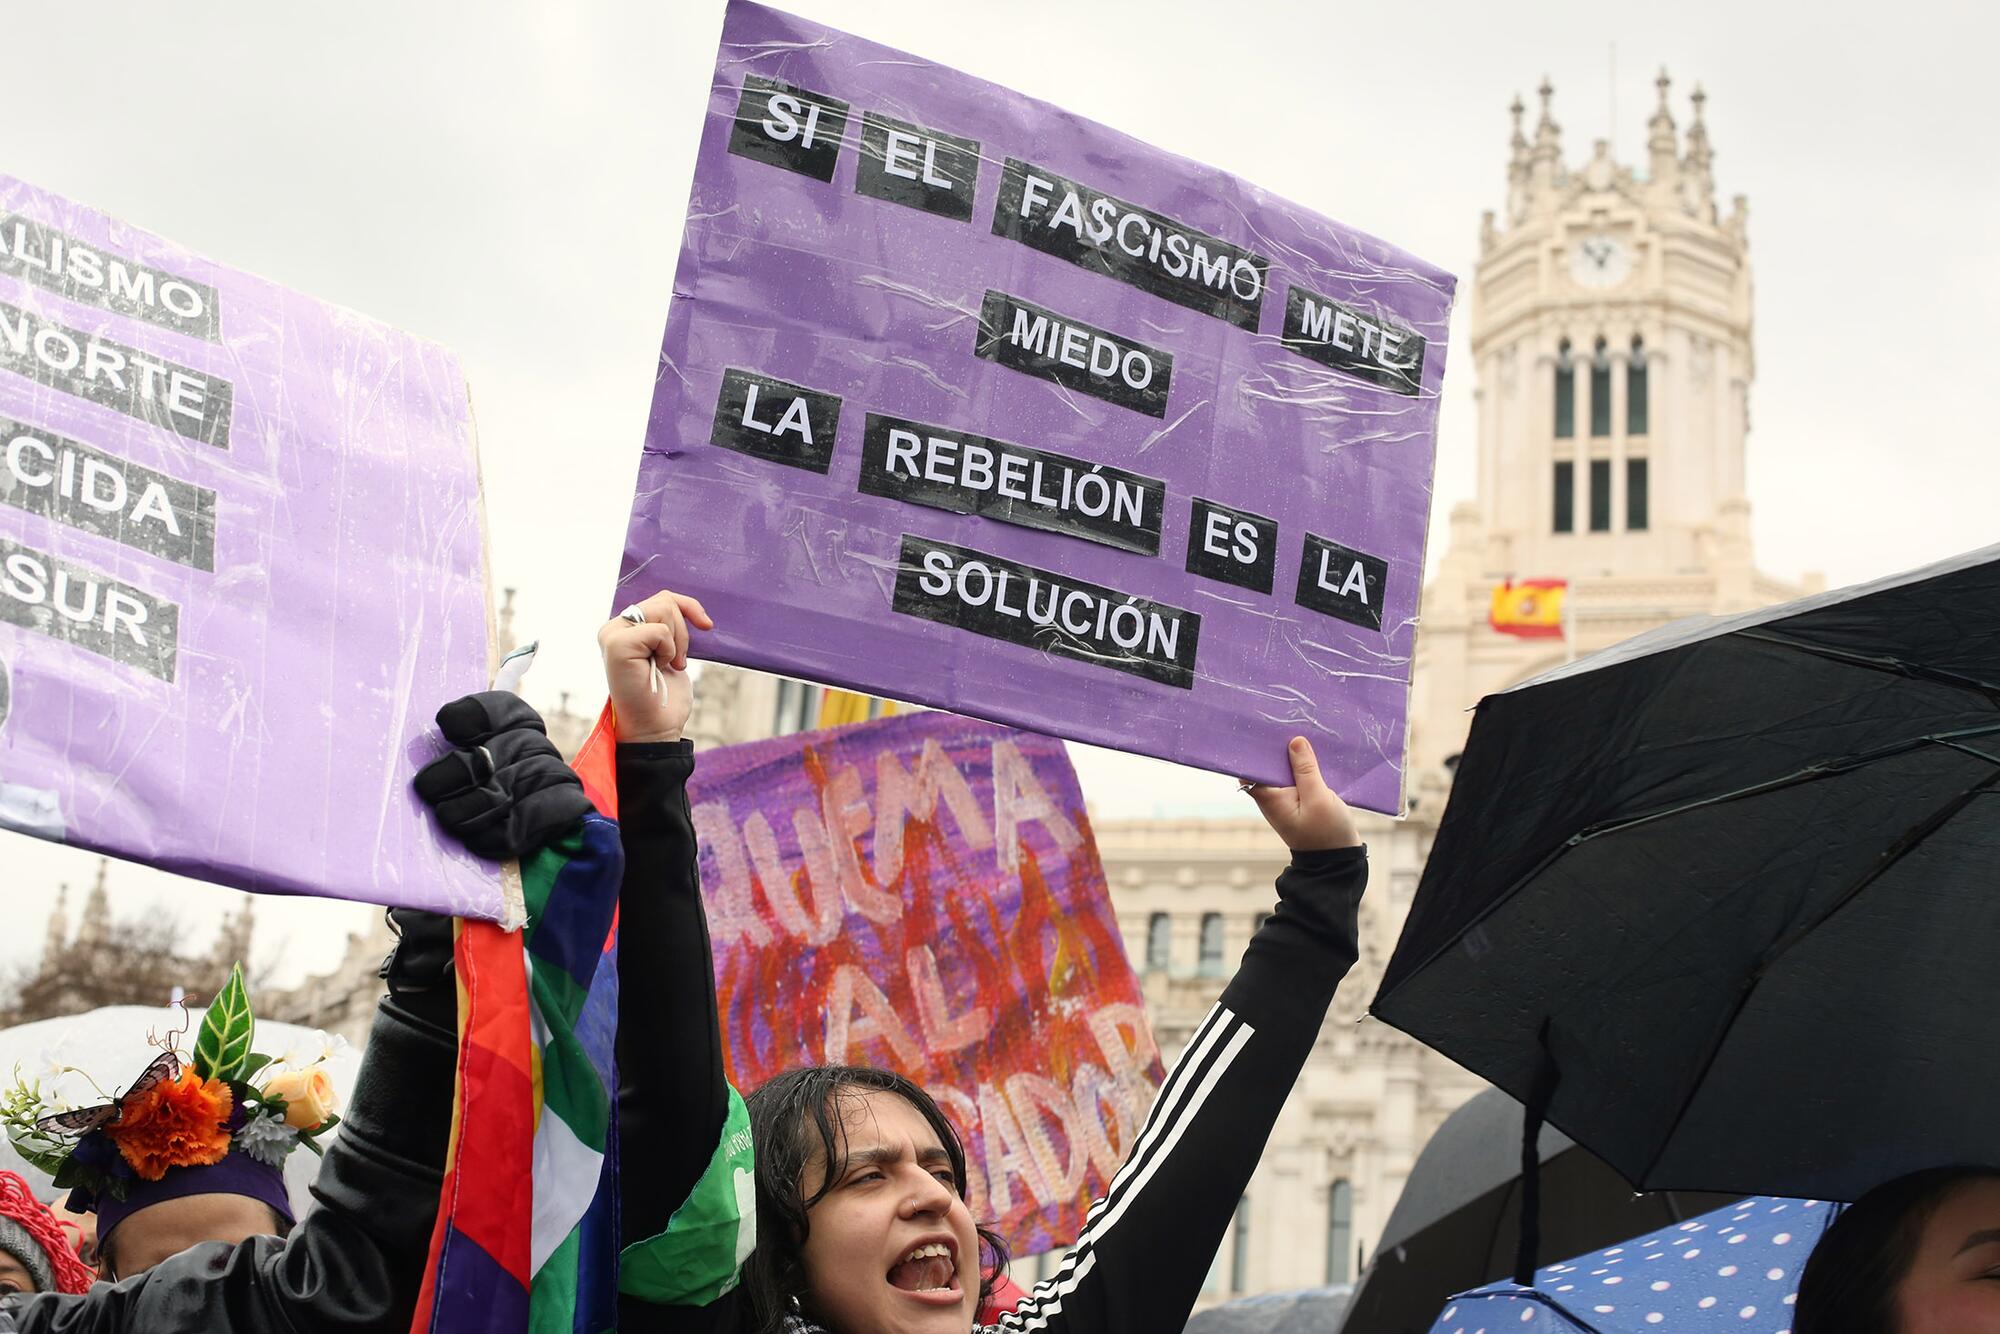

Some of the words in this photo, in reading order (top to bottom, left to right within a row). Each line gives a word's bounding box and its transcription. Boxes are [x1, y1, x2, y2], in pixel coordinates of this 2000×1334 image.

[0, 222, 204, 318] LISMO
[763, 95, 820, 149] SI
[884, 131, 952, 190] EL
[1301, 298, 1402, 369] METE
[1011, 308, 1153, 390] MIEDO
[6, 435, 182, 536] CIDA
[741, 384, 813, 445] LA
[885, 428, 1145, 527] REBELIÓN
[1203, 512, 1259, 564] ES
[1317, 549, 1369, 604] LA
[2, 554, 149, 647] SUR
[919, 551, 1180, 660] SOLUCIÓN
[825, 944, 991, 1074] AL
